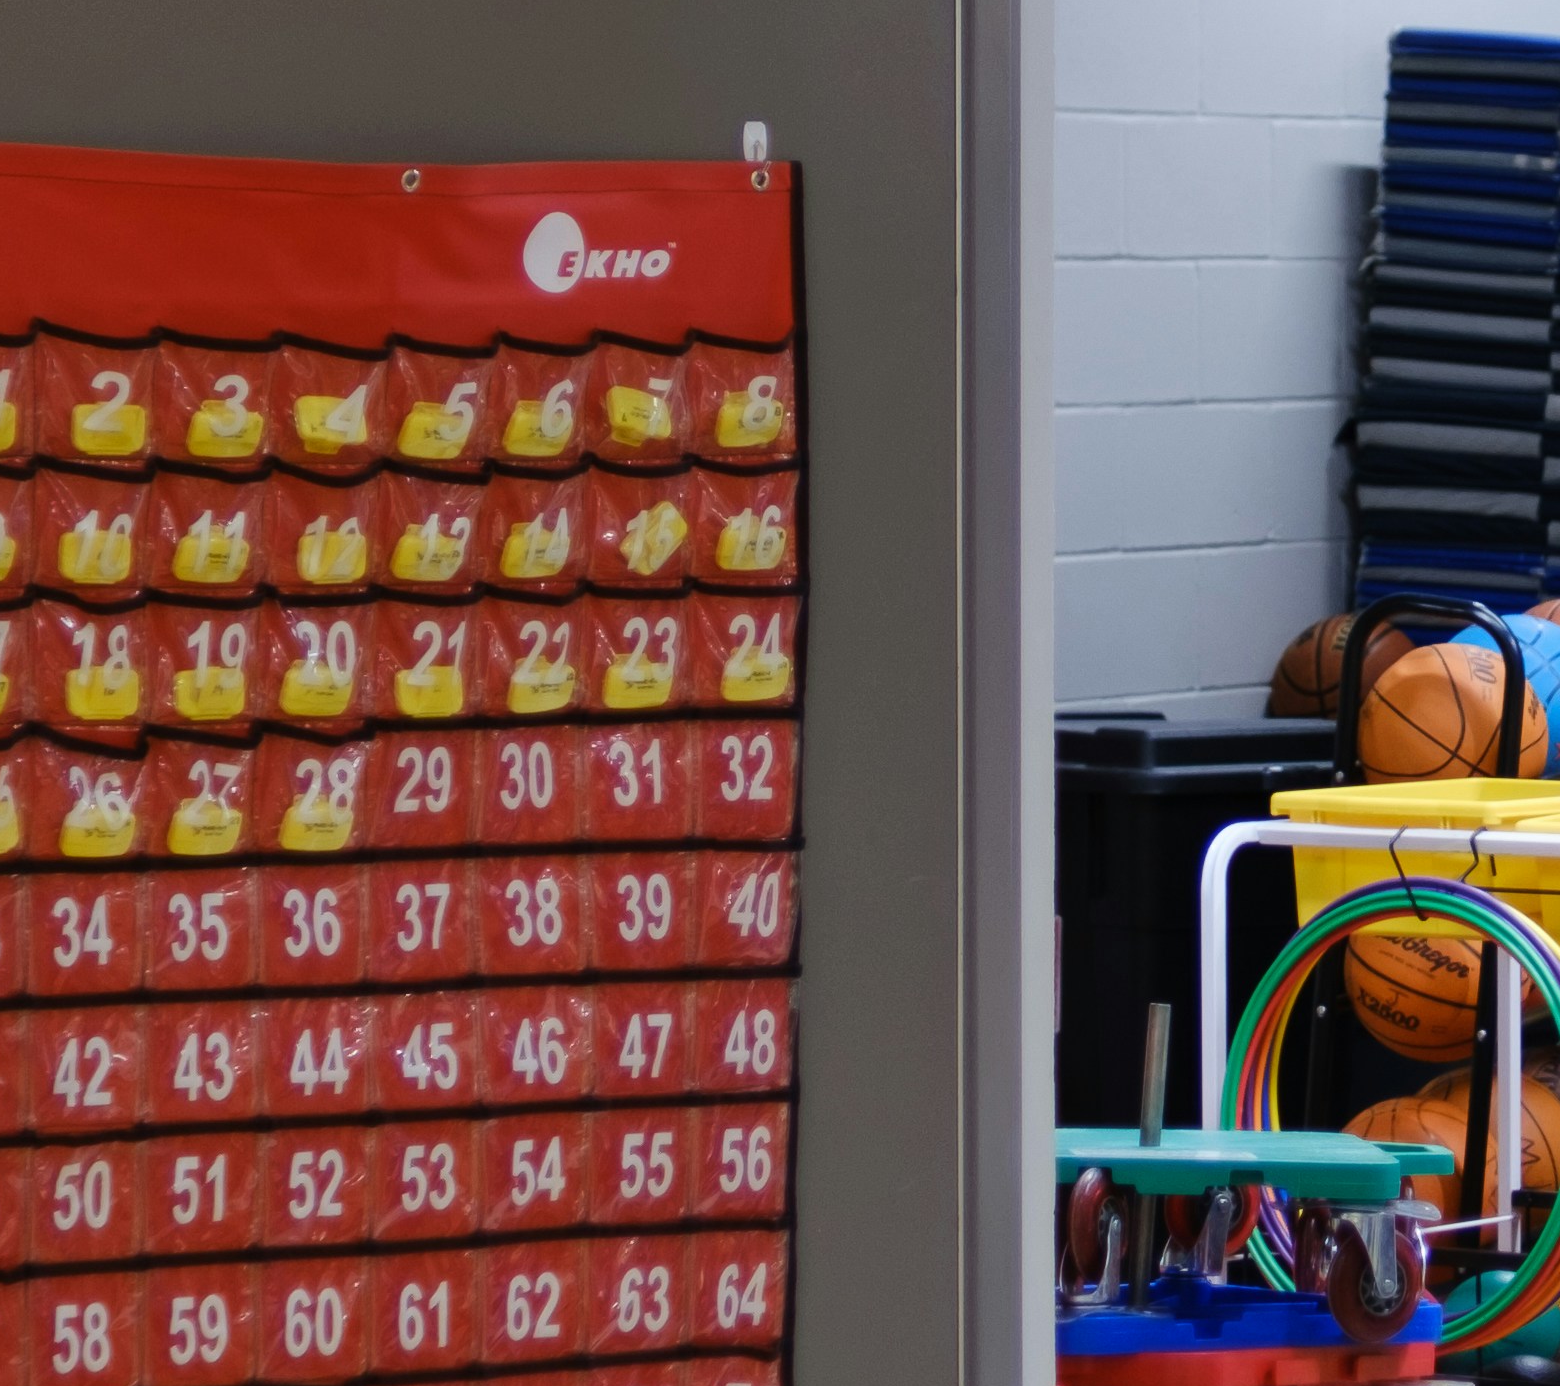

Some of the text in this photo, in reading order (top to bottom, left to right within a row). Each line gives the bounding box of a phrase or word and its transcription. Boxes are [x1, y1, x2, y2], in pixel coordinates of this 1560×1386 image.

[557, 250, 670, 278] EKHO
[82, 371, 130, 431] 2
[208, 374, 249, 436] 3
[325, 385, 367, 441] 4
[440, 381, 478, 440] 5
[541, 379, 574, 437] 6
[647, 378, 672, 433] 7
[742, 376, 777, 430] 8
[73, 510, 132, 576] 10
[190, 509, 246, 576] 11
[305, 515, 359, 577] 12
[419, 513, 470, 576] 13
[525, 508, 569, 573] 14
[731, 505, 781, 566] 16
[72, 622, 130, 688] 18
[187, 620, 246, 689] 19
[296, 620, 355, 685] 20
[407, 620, 466, 685] 21
[513, 620, 570, 684] 22
[623, 617, 677, 682] 23
[726, 613, 780, 676] 24
[66, 766, 130, 830] 26
[179, 760, 240, 824] 27
[296, 759, 355, 823] 28
[397, 746, 451, 813] 29
[500, 742, 555, 810] 30
[612, 739, 665, 806] 31
[721, 735, 774, 801] 32
[53, 896, 112, 966] 34
[169, 892, 229, 963] 35
[284, 888, 341, 958] 36
[397, 883, 451, 952] 37
[505, 877, 562, 946] 38
[617, 873, 673, 941] 39
[727, 871, 779, 938] 40
[1374, 935, 1470, 979] Gregor
[54, 1037, 114, 1107] 42
[174, 1032, 235, 1102] 43
[290, 1028, 350, 1095] 44
[401, 1023, 458, 1091] 45
[512, 1017, 566, 1084] 46
[619, 1013, 672, 1078] 47
[724, 1009, 776, 1075] 48
[53, 1160, 112, 1231] 50
[172, 1155, 227, 1225] 51
[289, 1149, 346, 1220] 52
[401, 1144, 457, 1213] 53
[512, 1137, 566, 1207] 54
[619, 1131, 675, 1200] 55
[718, 1126, 772, 1193] 56
[52, 1302, 111, 1374] 58
[169, 1295, 230, 1366] 59
[285, 1287, 344, 1359] 60
[398, 1281, 451, 1350] 61
[506, 1272, 562, 1341] 62
[617, 1266, 671, 1333] 63
[715, 1262, 768, 1328] 64
